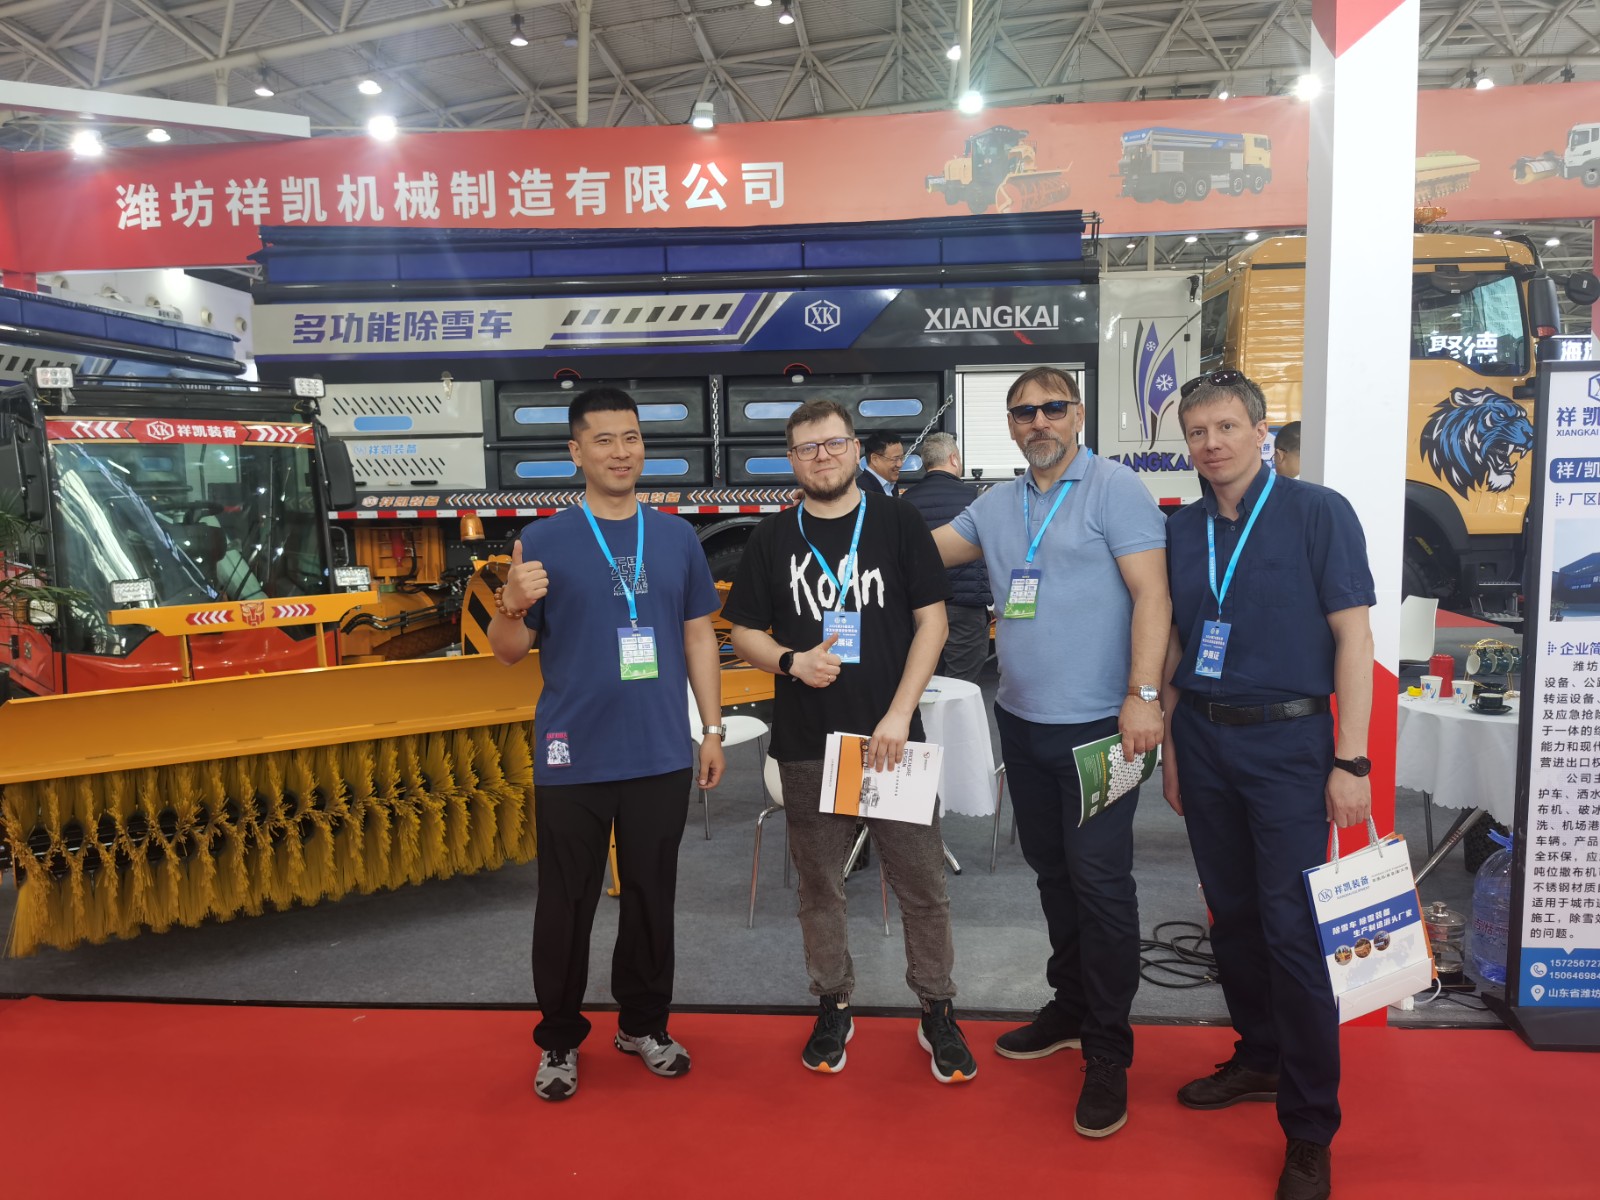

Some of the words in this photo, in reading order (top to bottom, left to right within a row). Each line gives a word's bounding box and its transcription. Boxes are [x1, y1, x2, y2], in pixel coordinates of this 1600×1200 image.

[116, 162, 784, 230] 潍坊祥凯机械制造有限公司
[293, 309, 512, 344] 多功能除雪车
[925, 305, 1060, 329] XIANGKAI
[1556, 407, 1600, 427] 祥凯
[176, 424, 236, 438] 祥凯装备
[1105, 451, 1195, 472] ANGKAI
[1568, 493, 1600, 505] 厂区
[1573, 661, 1598, 671] 潍坊
[1533, 882, 1600, 893] 不锈钢材质
